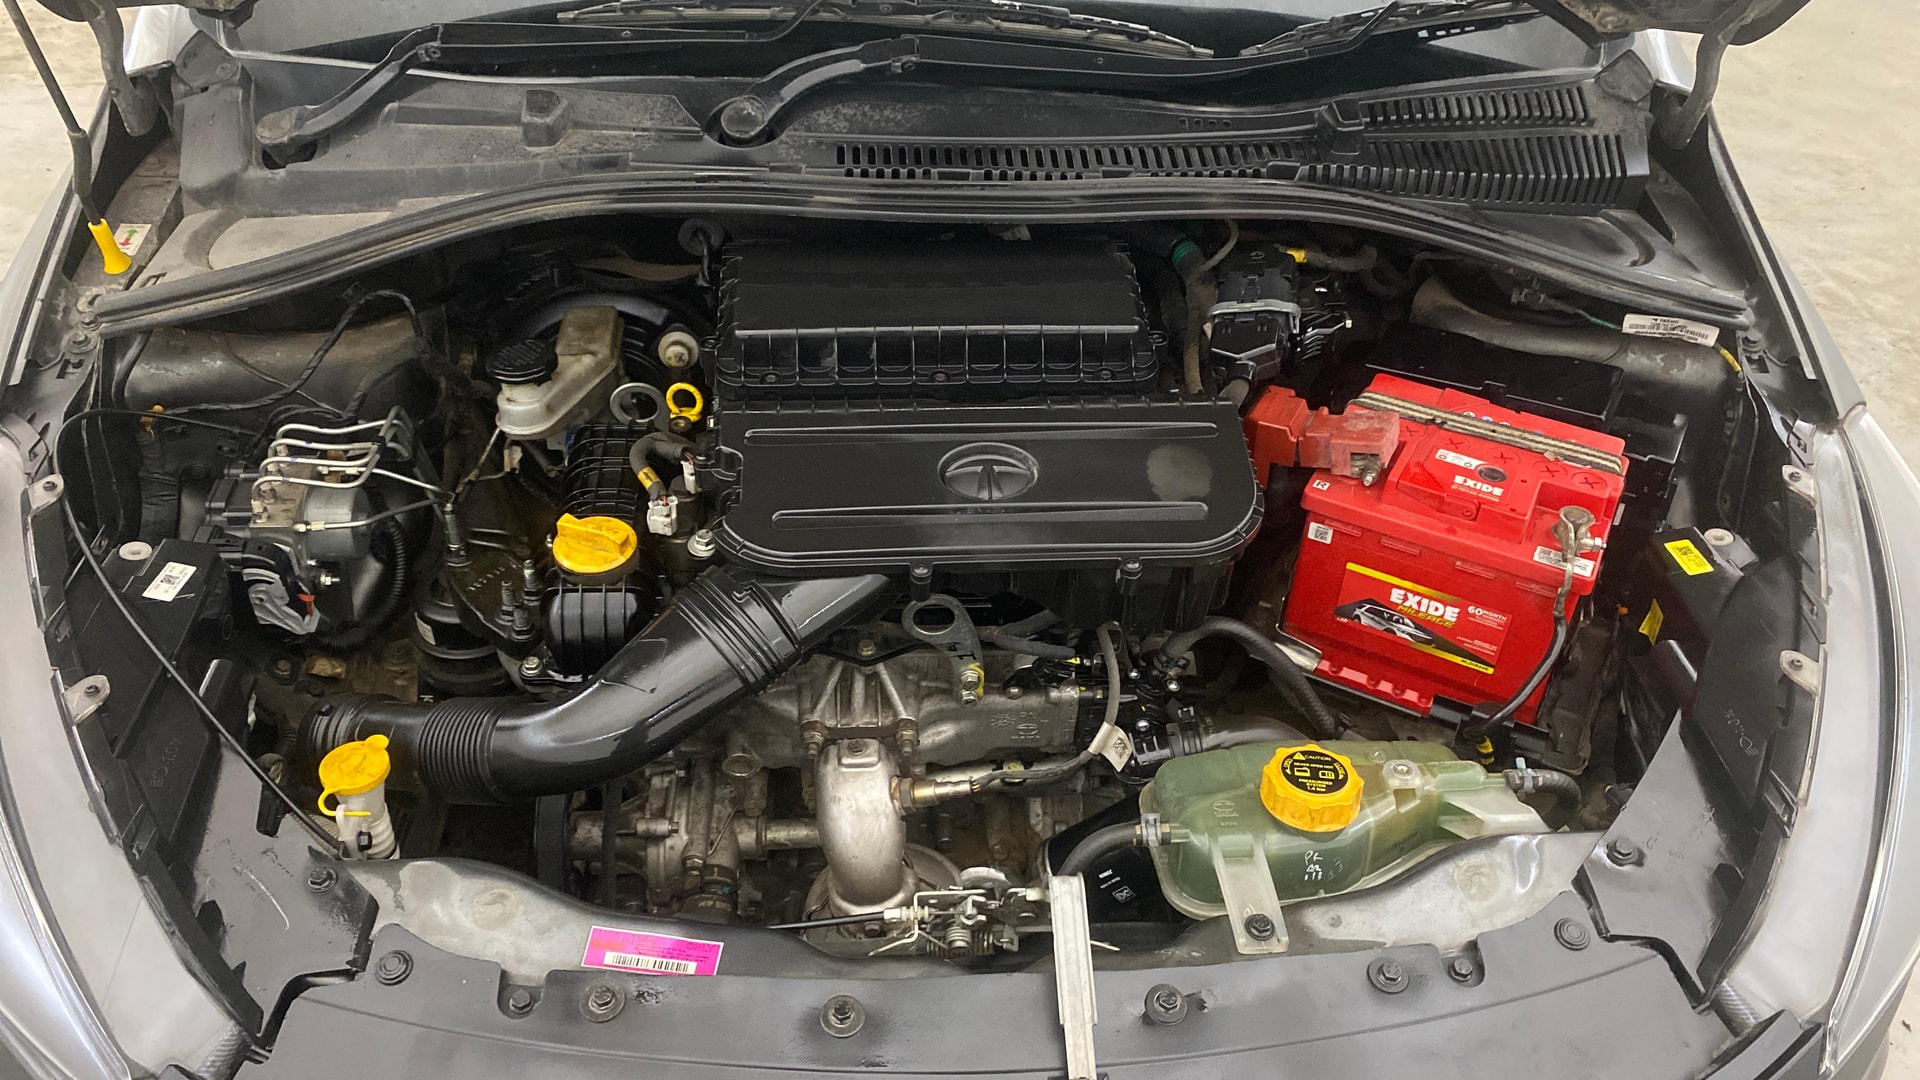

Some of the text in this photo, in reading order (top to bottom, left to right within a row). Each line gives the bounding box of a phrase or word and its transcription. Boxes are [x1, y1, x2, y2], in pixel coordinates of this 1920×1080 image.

[1453, 475, 1504, 496] EXIDE
[1389, 587, 1461, 622] EXIDE
[1467, 605, 1508, 621] 60 MONTH
[1396, 605, 1456, 629] MILEAGE
